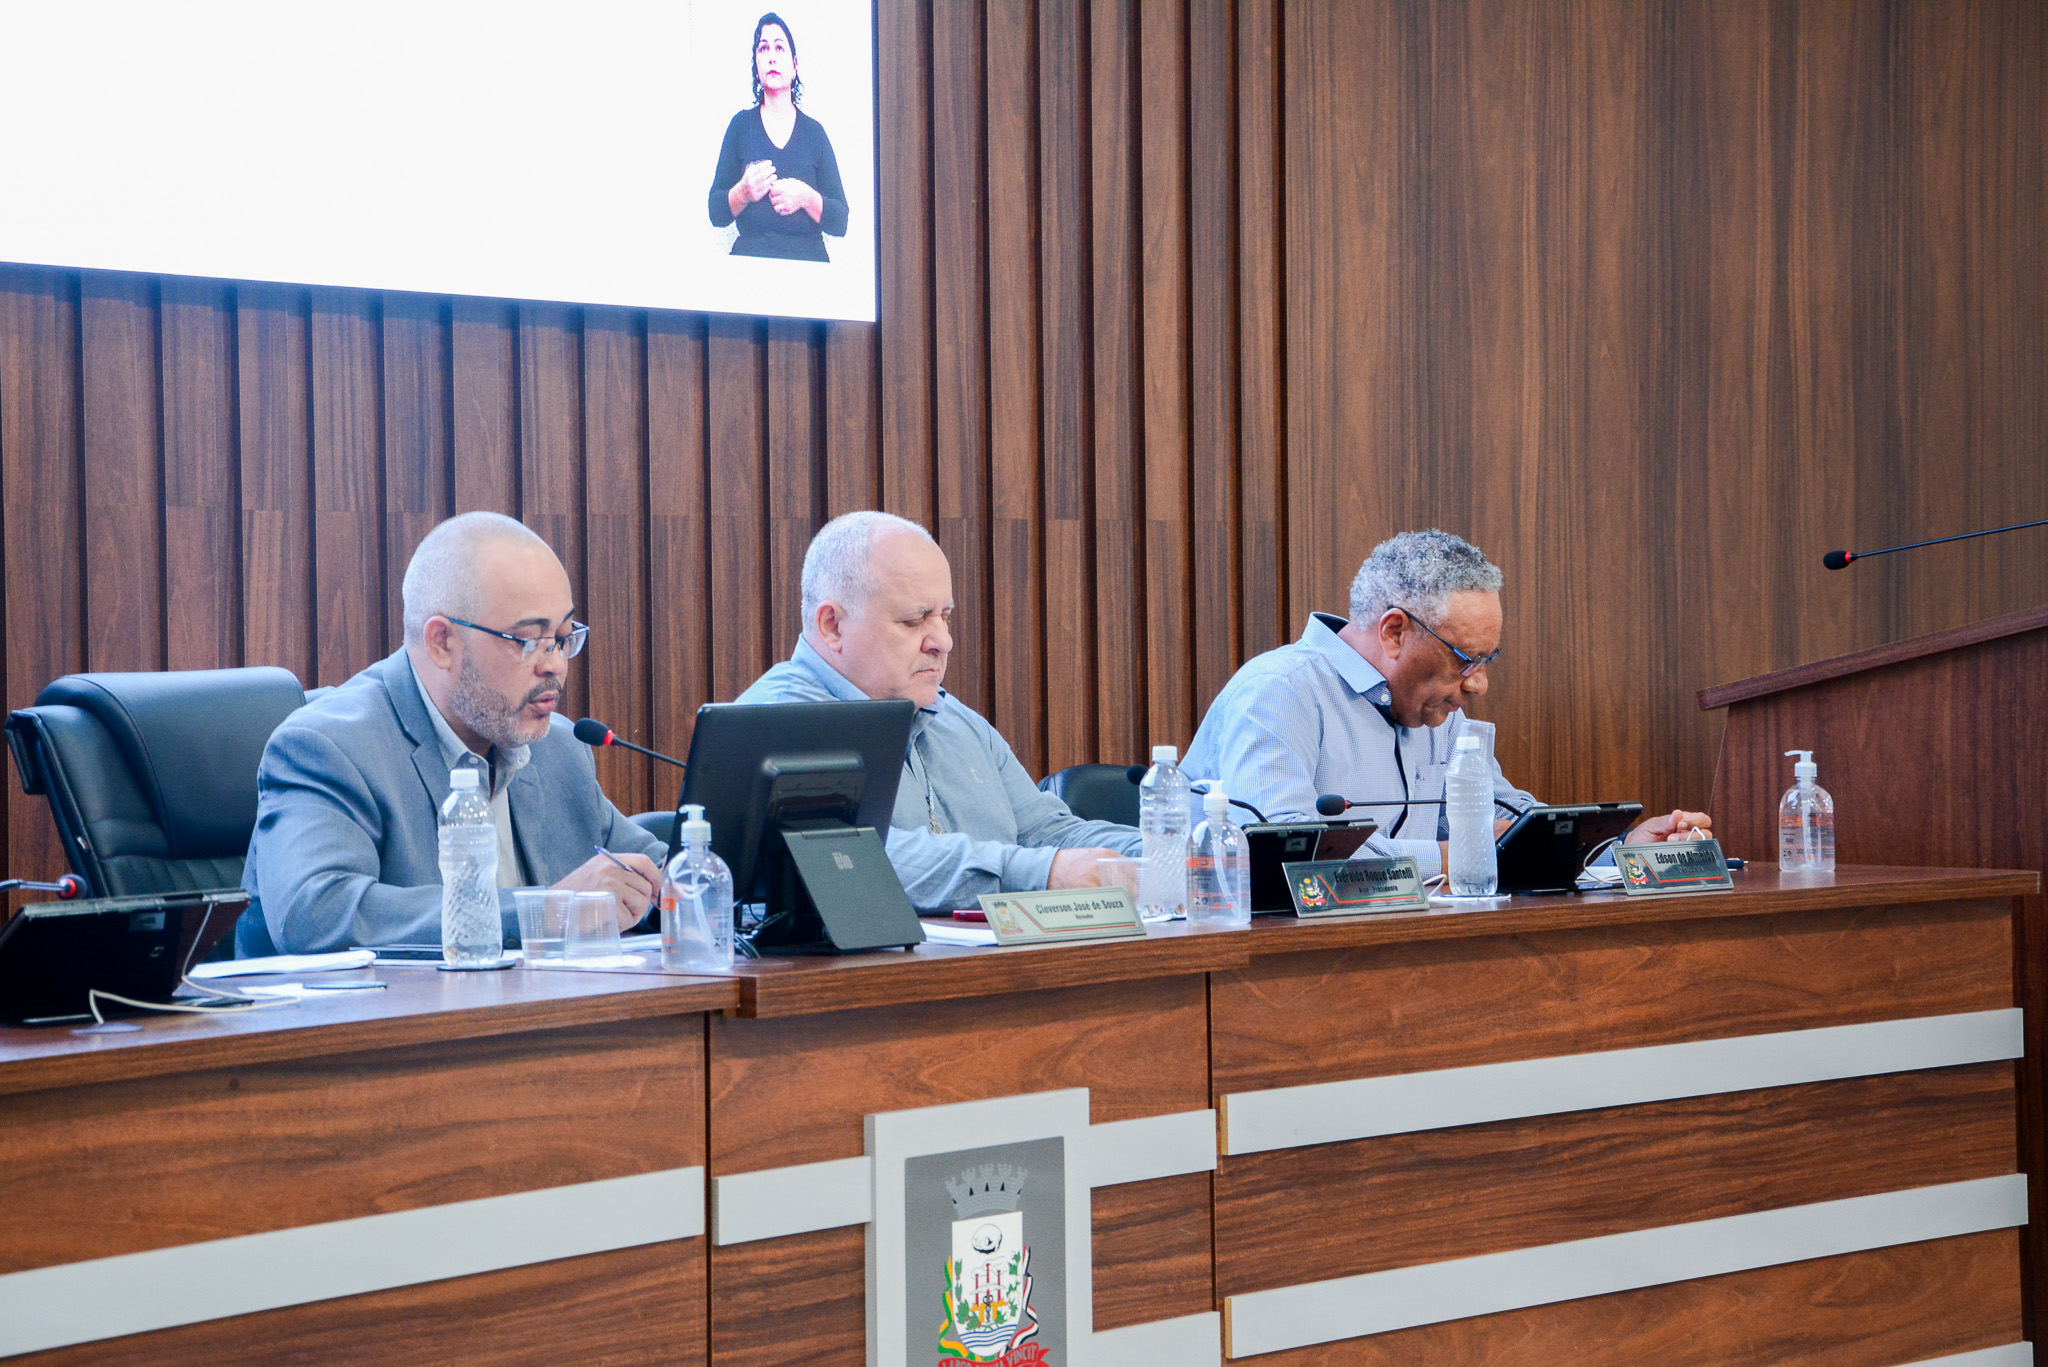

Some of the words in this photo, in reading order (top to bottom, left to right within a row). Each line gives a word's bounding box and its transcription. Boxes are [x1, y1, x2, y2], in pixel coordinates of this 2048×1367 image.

[1655, 852, 1677, 864] Edson
[1677, 851, 1687, 863] de
[1333, 870, 1365, 884] Everaldo
[1364, 869, 1387, 882] Roque
[1386, 867, 1414, 881] Santelli
[1035, 903, 1073, 914] Cleverson
[1073, 901, 1091, 912] José
[1091, 899, 1101, 910] de
[1101, 899, 1124, 909] Souza
[1006, 1346, 1035, 1367] VINCIT
